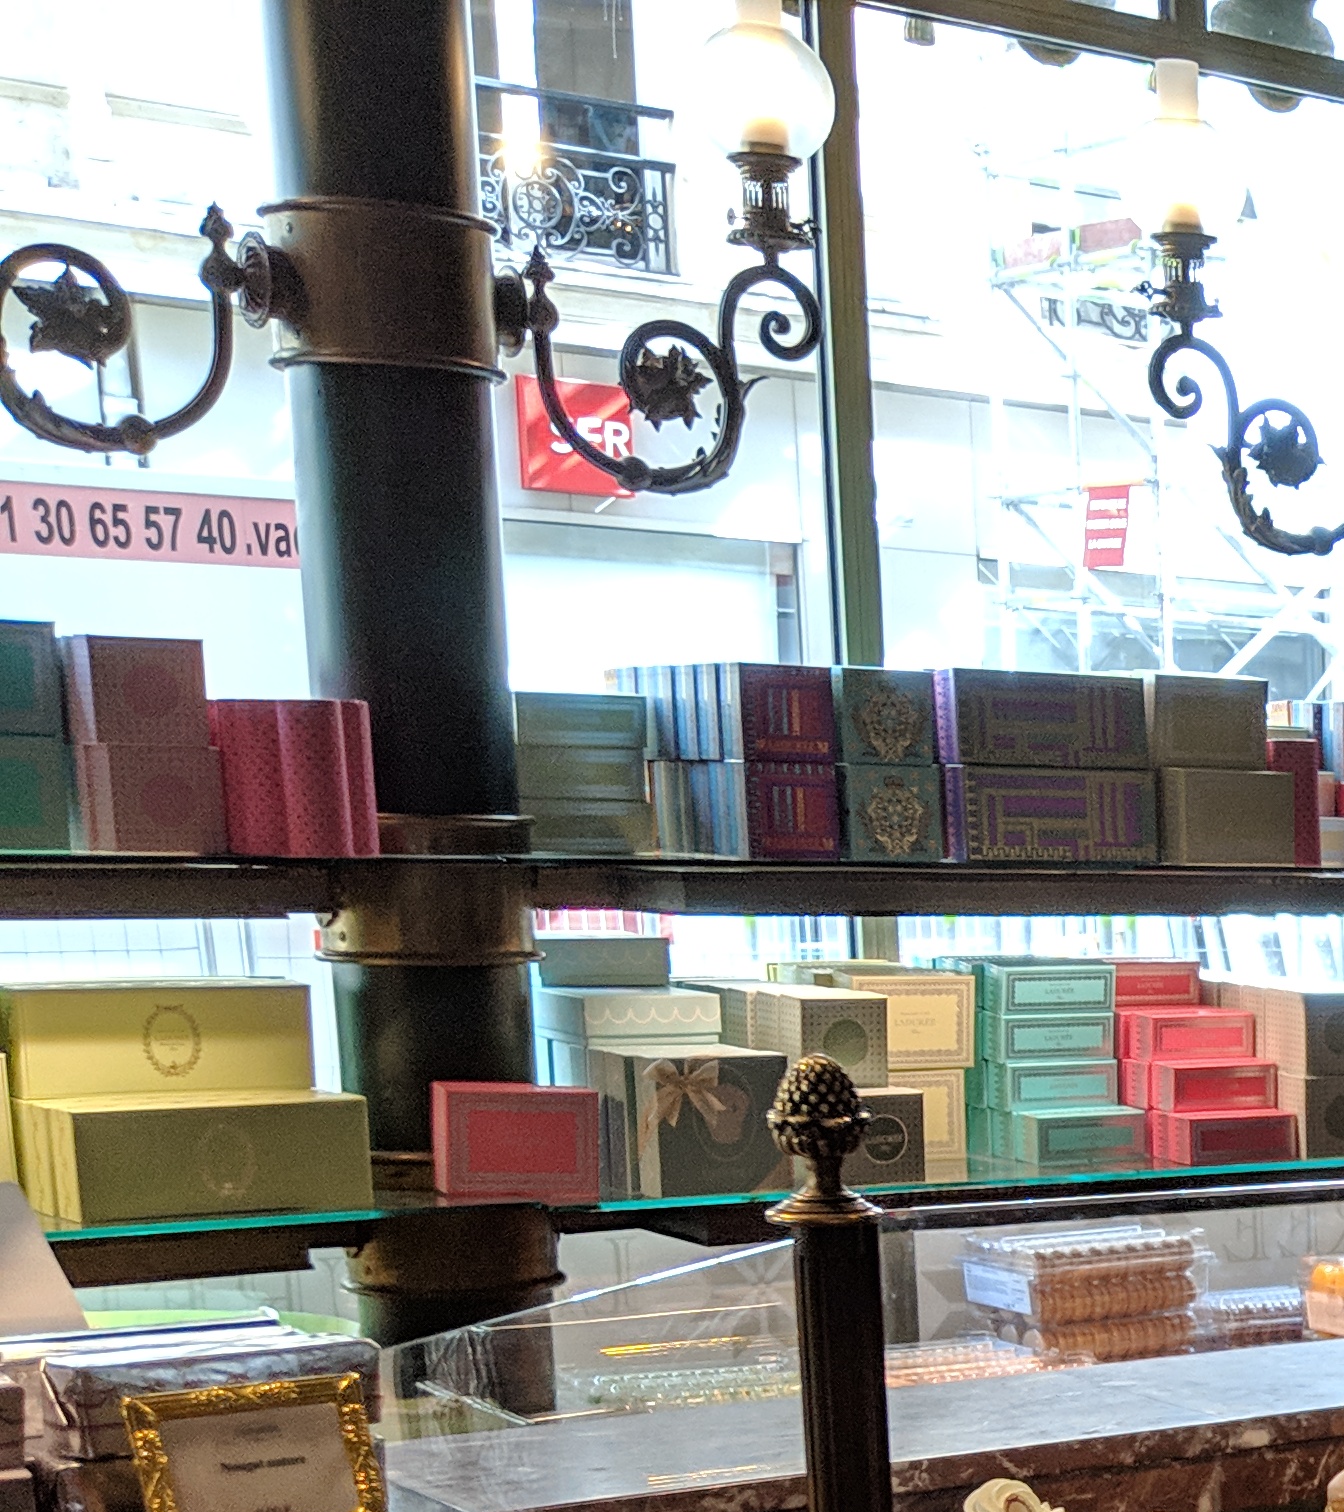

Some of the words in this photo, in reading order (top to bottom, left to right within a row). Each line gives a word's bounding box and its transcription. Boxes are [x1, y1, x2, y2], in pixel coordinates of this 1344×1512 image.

[32, 497, 76, 547] 30
[89, 501, 132, 550] 65
[144, 505, 182, 552] 57
[197, 508, 237, 555] 40
